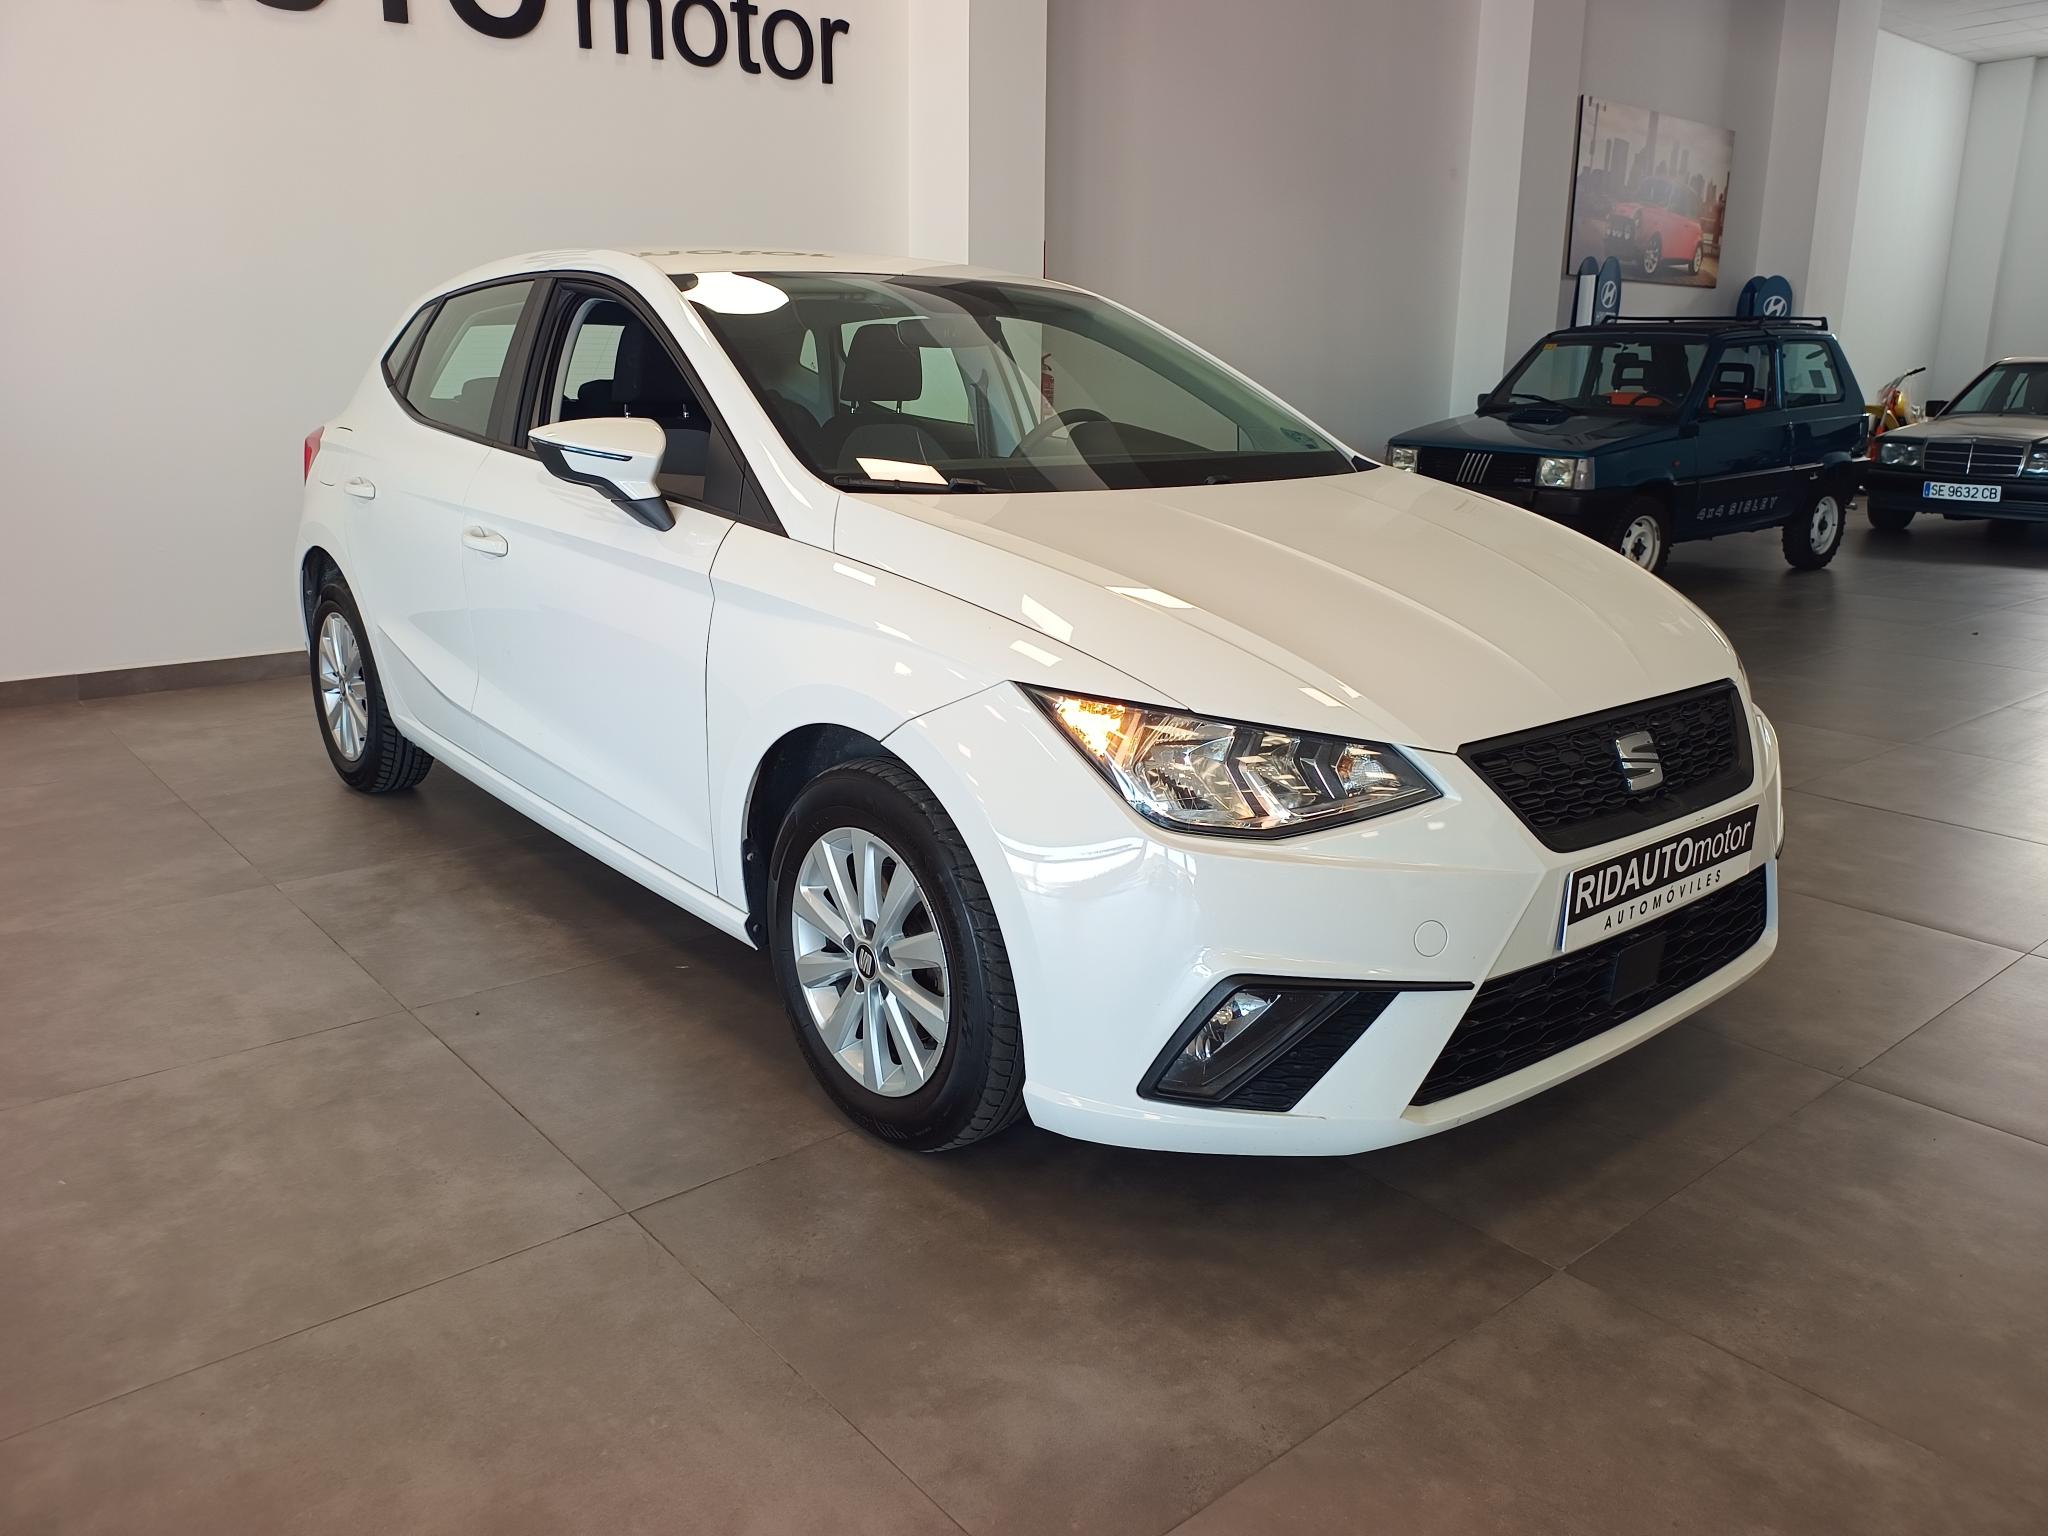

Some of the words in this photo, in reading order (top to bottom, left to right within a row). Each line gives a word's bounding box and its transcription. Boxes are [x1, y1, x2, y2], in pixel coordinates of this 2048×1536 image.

[1931, 484, 1946, 497] SE
[1947, 485, 1979, 499] 9632
[1981, 487, 1998, 500] CB
[1574, 820, 1752, 915] RIDAUTOmotor
[1603, 869, 1722, 931] AUTOMÓVILES
